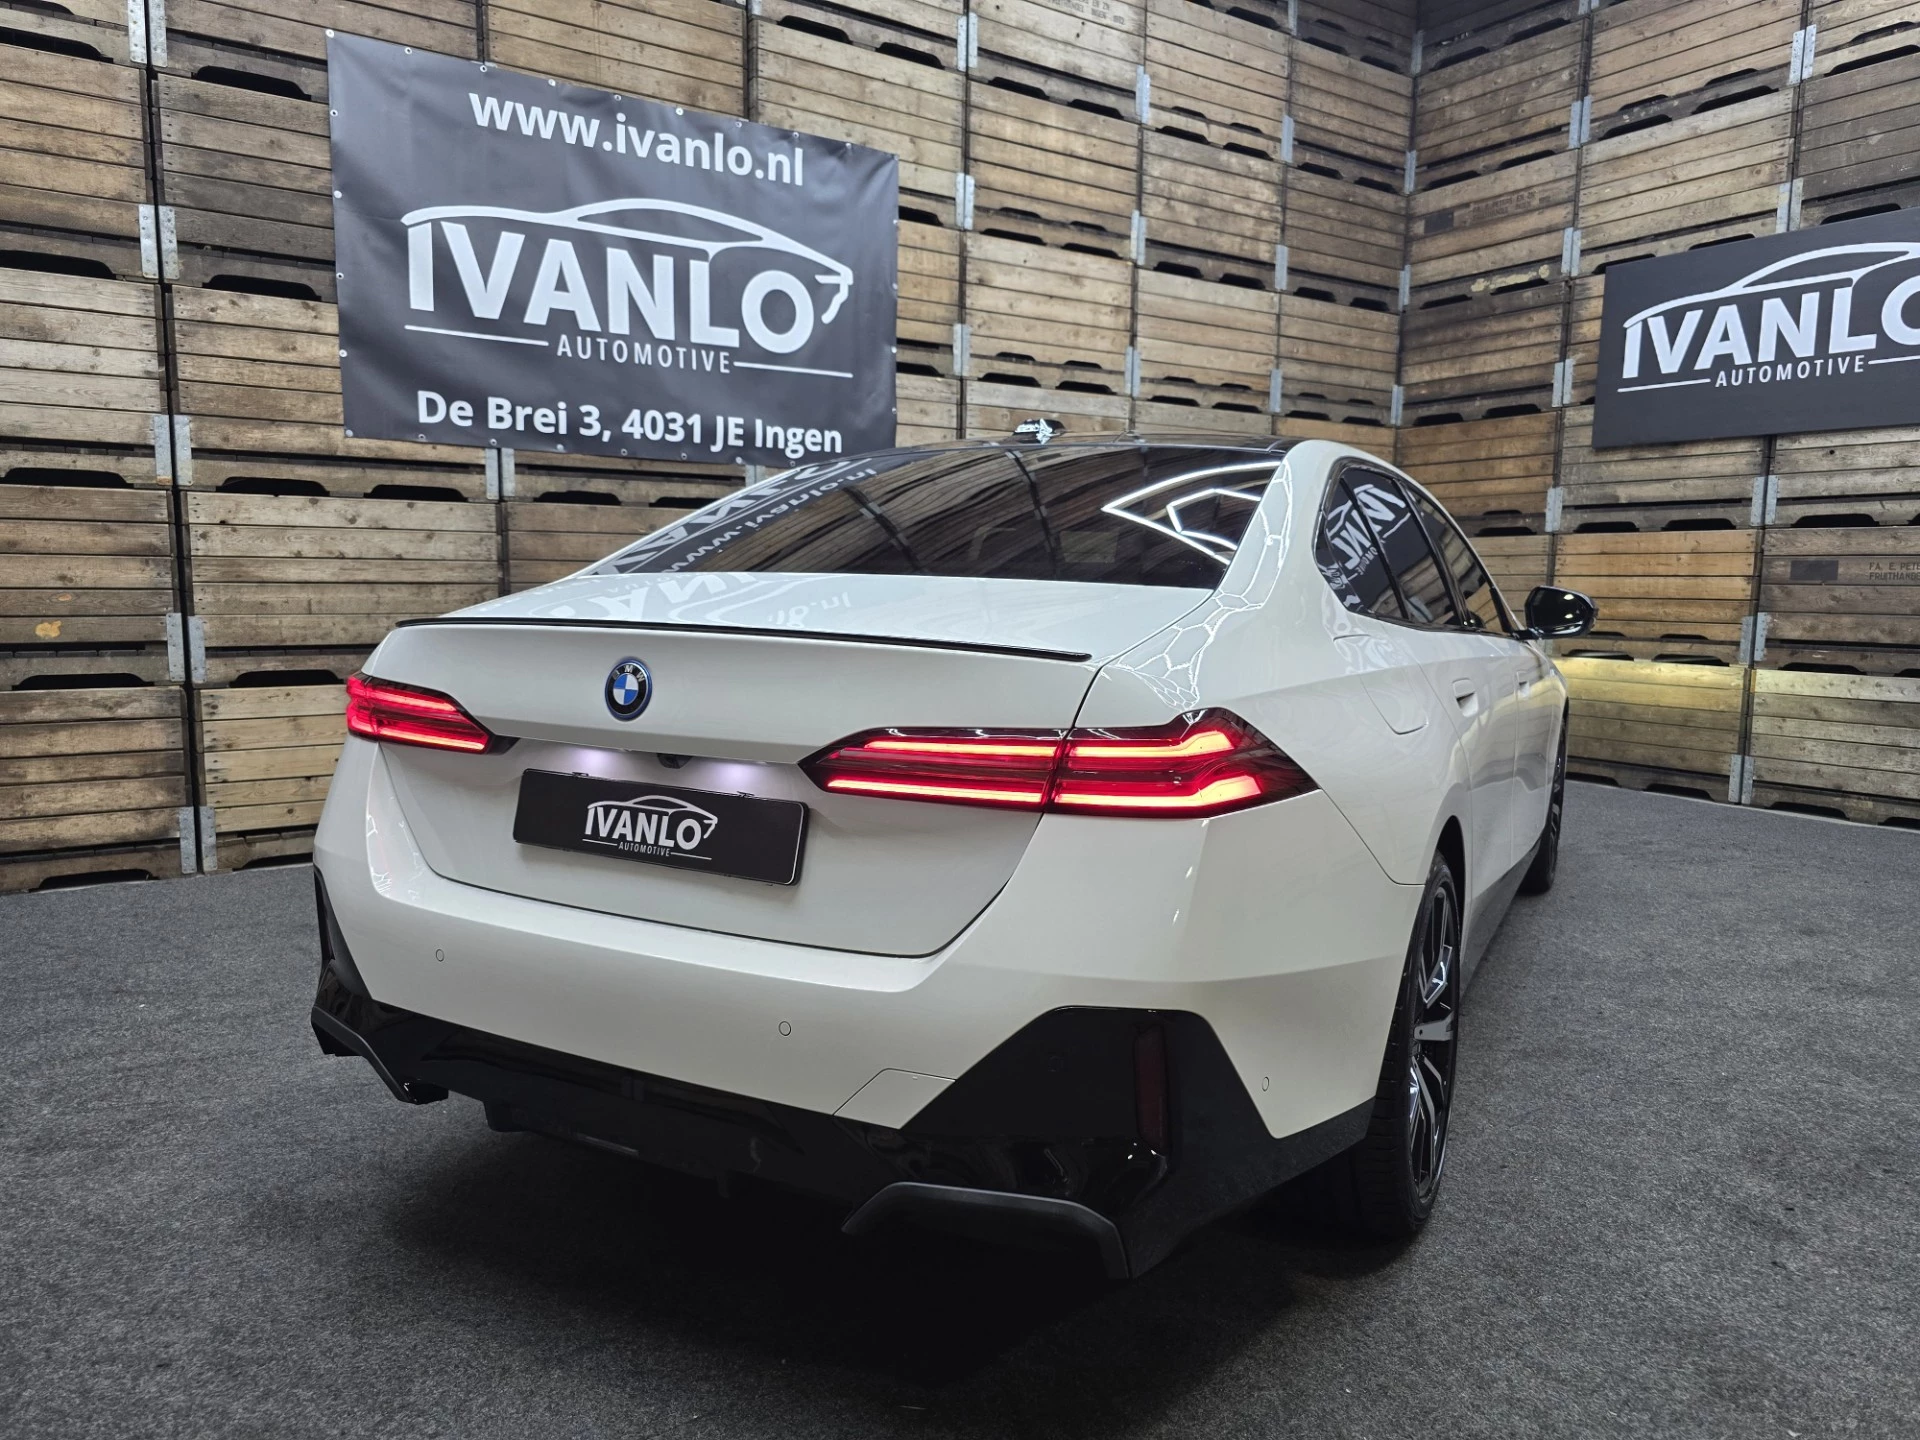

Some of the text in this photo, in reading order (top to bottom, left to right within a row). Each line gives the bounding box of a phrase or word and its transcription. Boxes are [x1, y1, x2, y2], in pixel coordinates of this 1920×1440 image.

[469, 92, 803, 186] www.ivanlo.nl
[407, 220, 815, 354] IVANLO
[556, 333, 731, 374] AUTOMOTIVE
[1714, 354, 1866, 388] AUTOMOTIVE
[417, 389, 843, 460] De Brei 3, 4031 JE Ingen
[611, 664, 646, 682] BMW
[584, 806, 702, 851] IVANLO
[618, 841, 671, 857] AUTOMOTIVE
